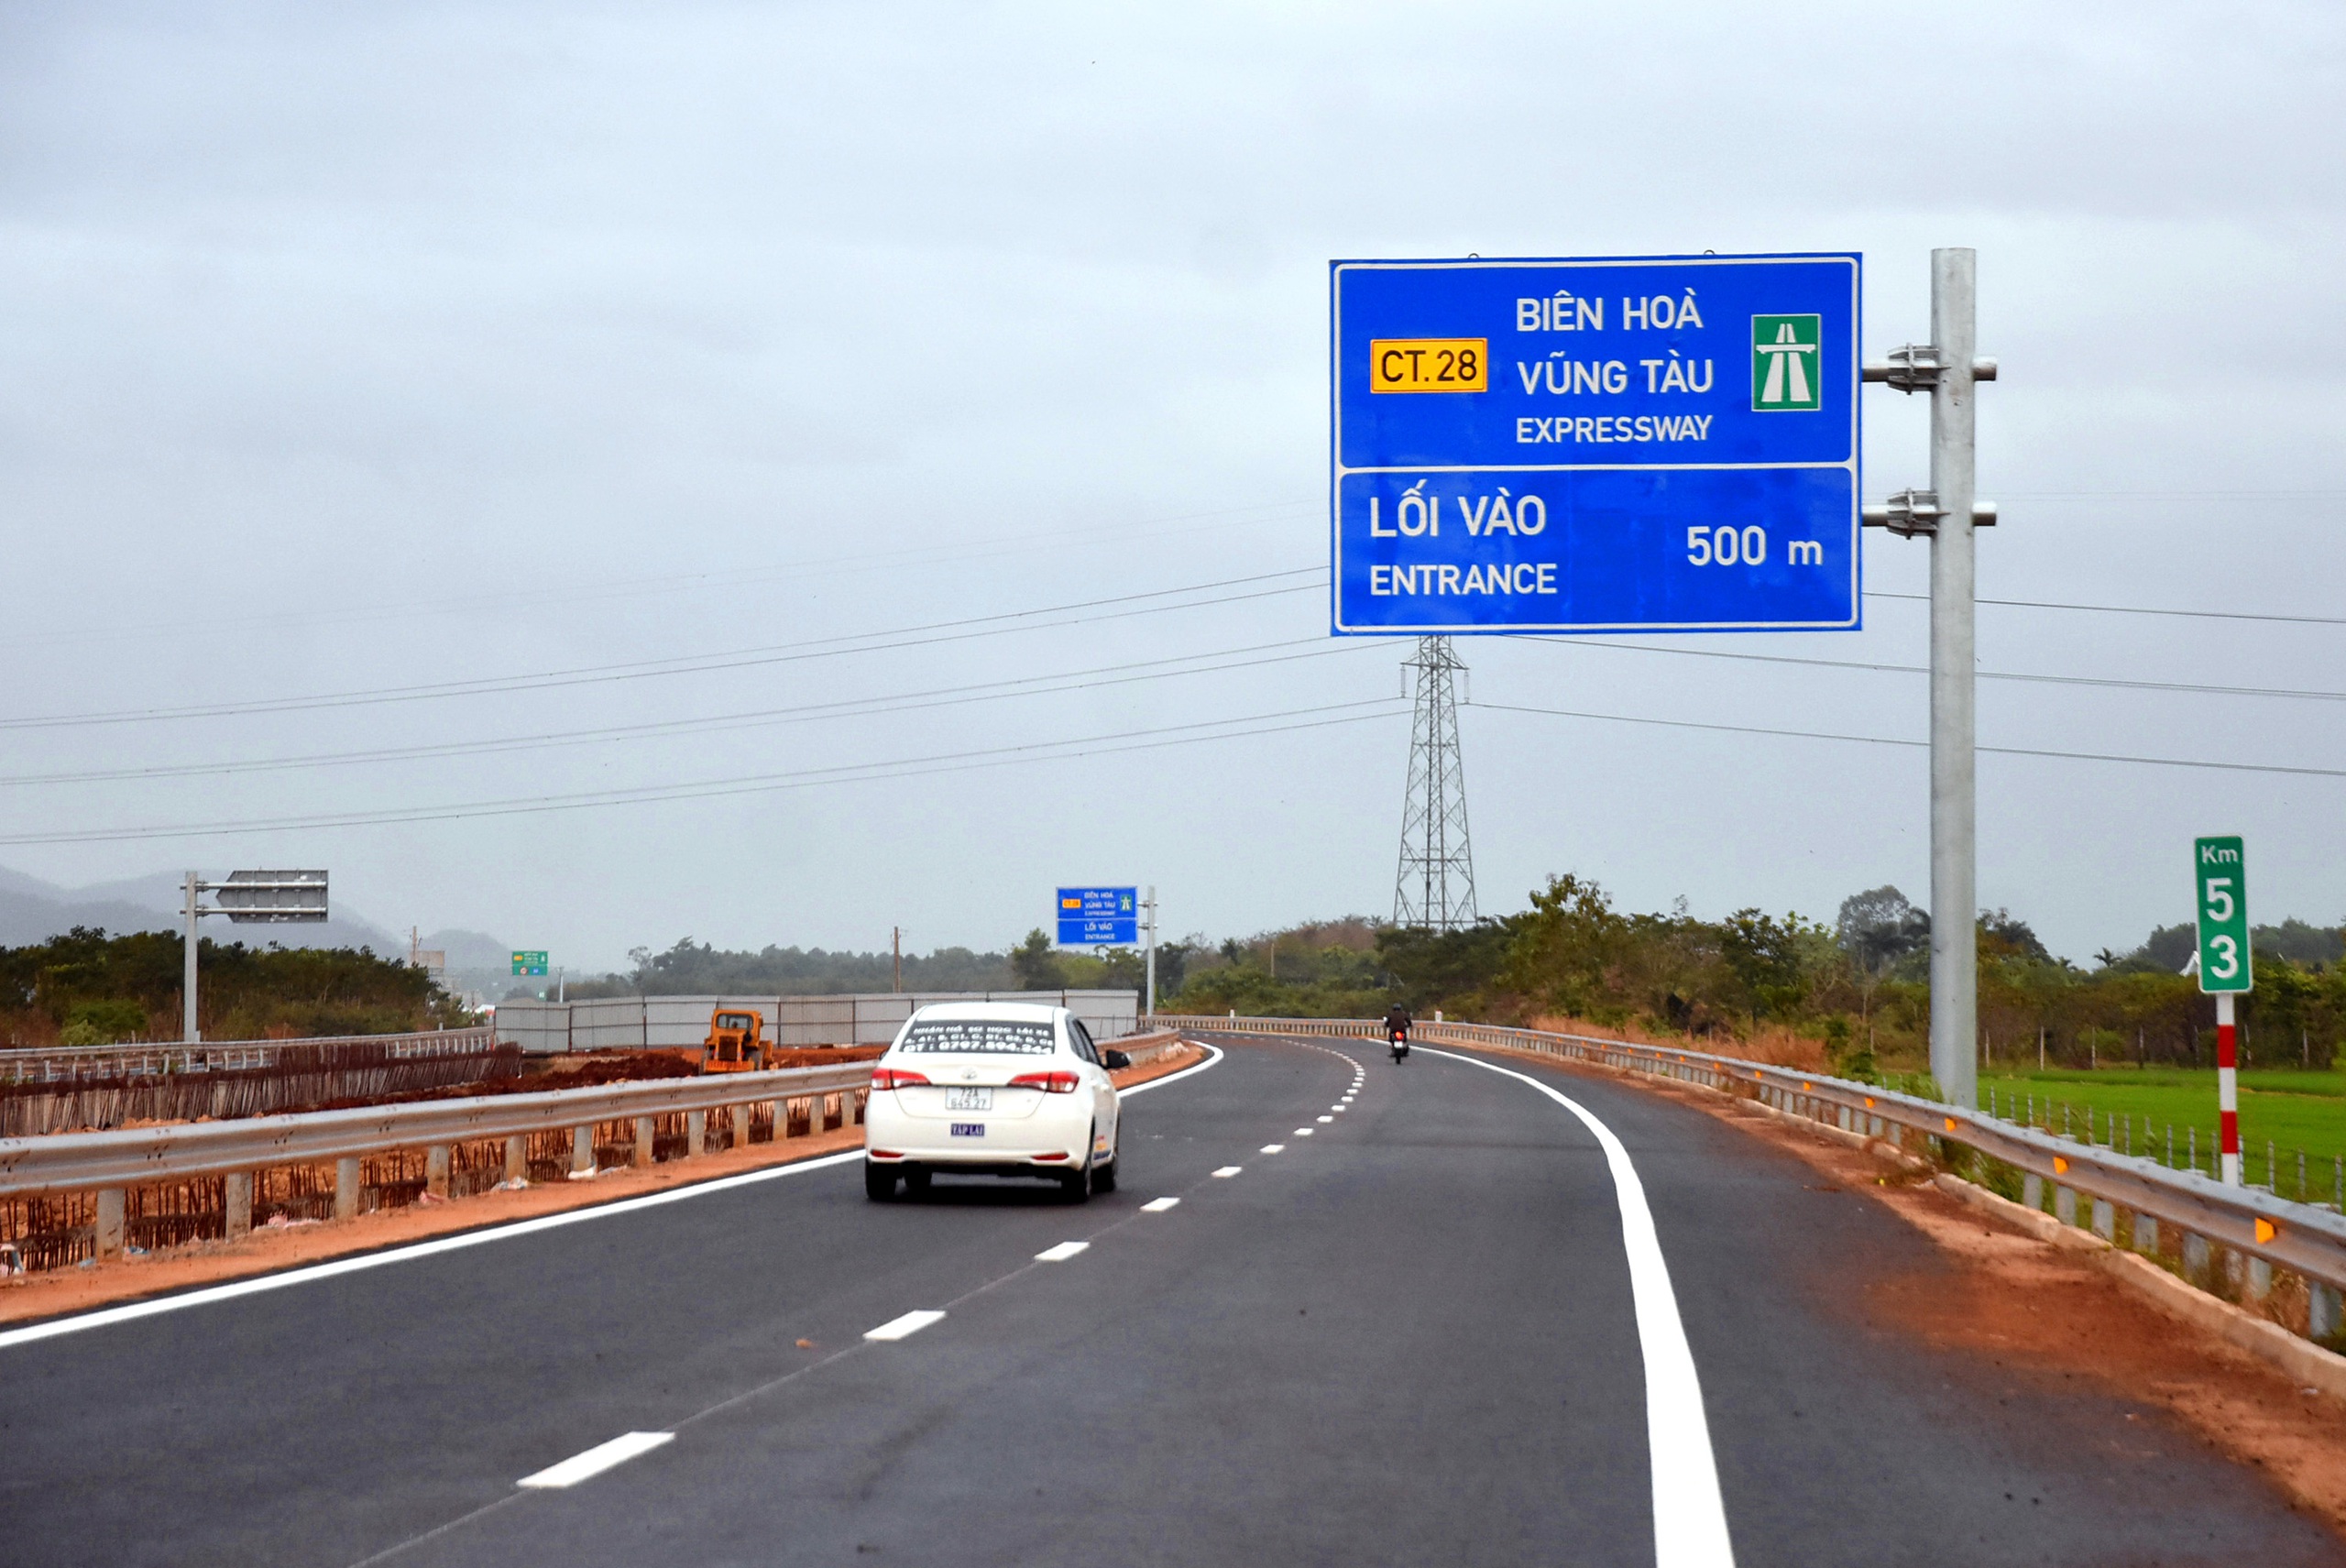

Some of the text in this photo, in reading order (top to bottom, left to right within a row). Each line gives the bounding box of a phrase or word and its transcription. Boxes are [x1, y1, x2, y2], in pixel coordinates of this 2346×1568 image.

[1517, 287, 1704, 332] BIÊN HOÀ
[1381, 349, 1477, 382] CT.28
[1517, 349, 1713, 395] VŨNG TÀU
[1517, 414, 1713, 444] EXPRESSWAY
[1370, 478, 1546, 538] LỐI VÀO
[1687, 525, 1823, 566] 500 m
[1370, 563, 1557, 596] ENTRANCE
[2201, 845, 2238, 864] Km
